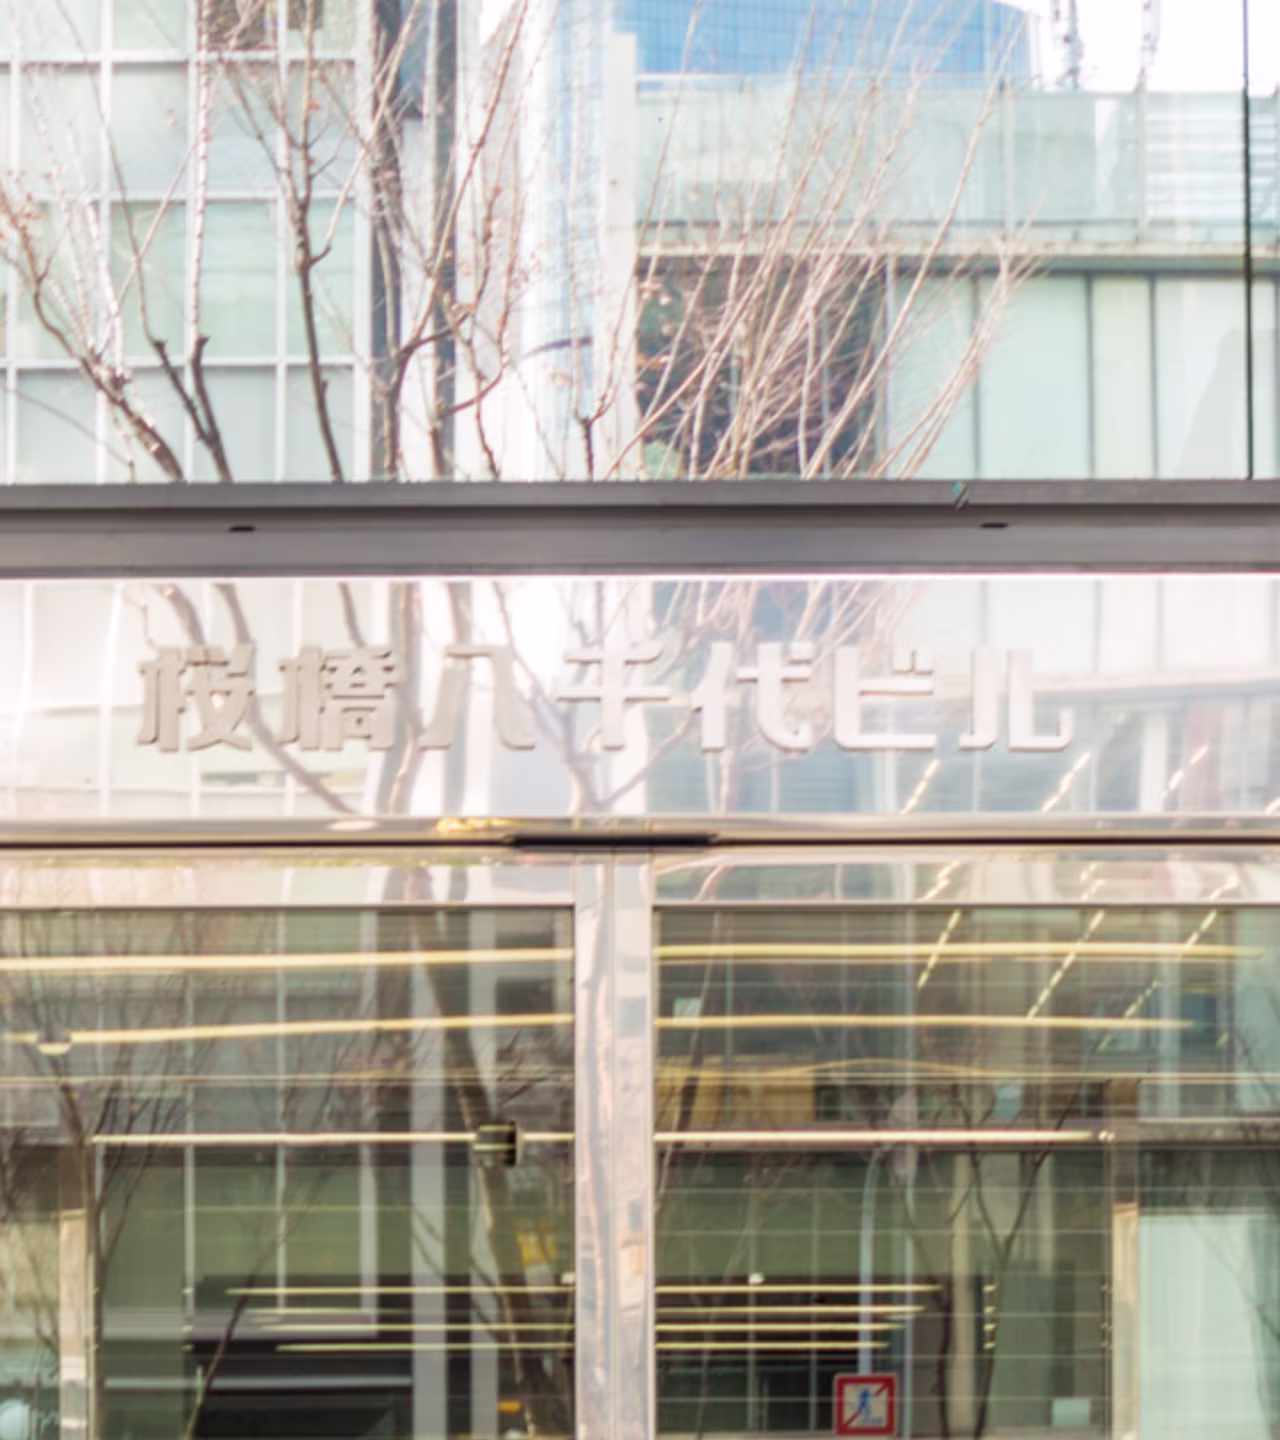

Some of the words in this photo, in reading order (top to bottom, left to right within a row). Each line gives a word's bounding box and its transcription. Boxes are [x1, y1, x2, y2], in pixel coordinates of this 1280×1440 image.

[137, 645, 1074, 752] 桜橋八千代ビル
